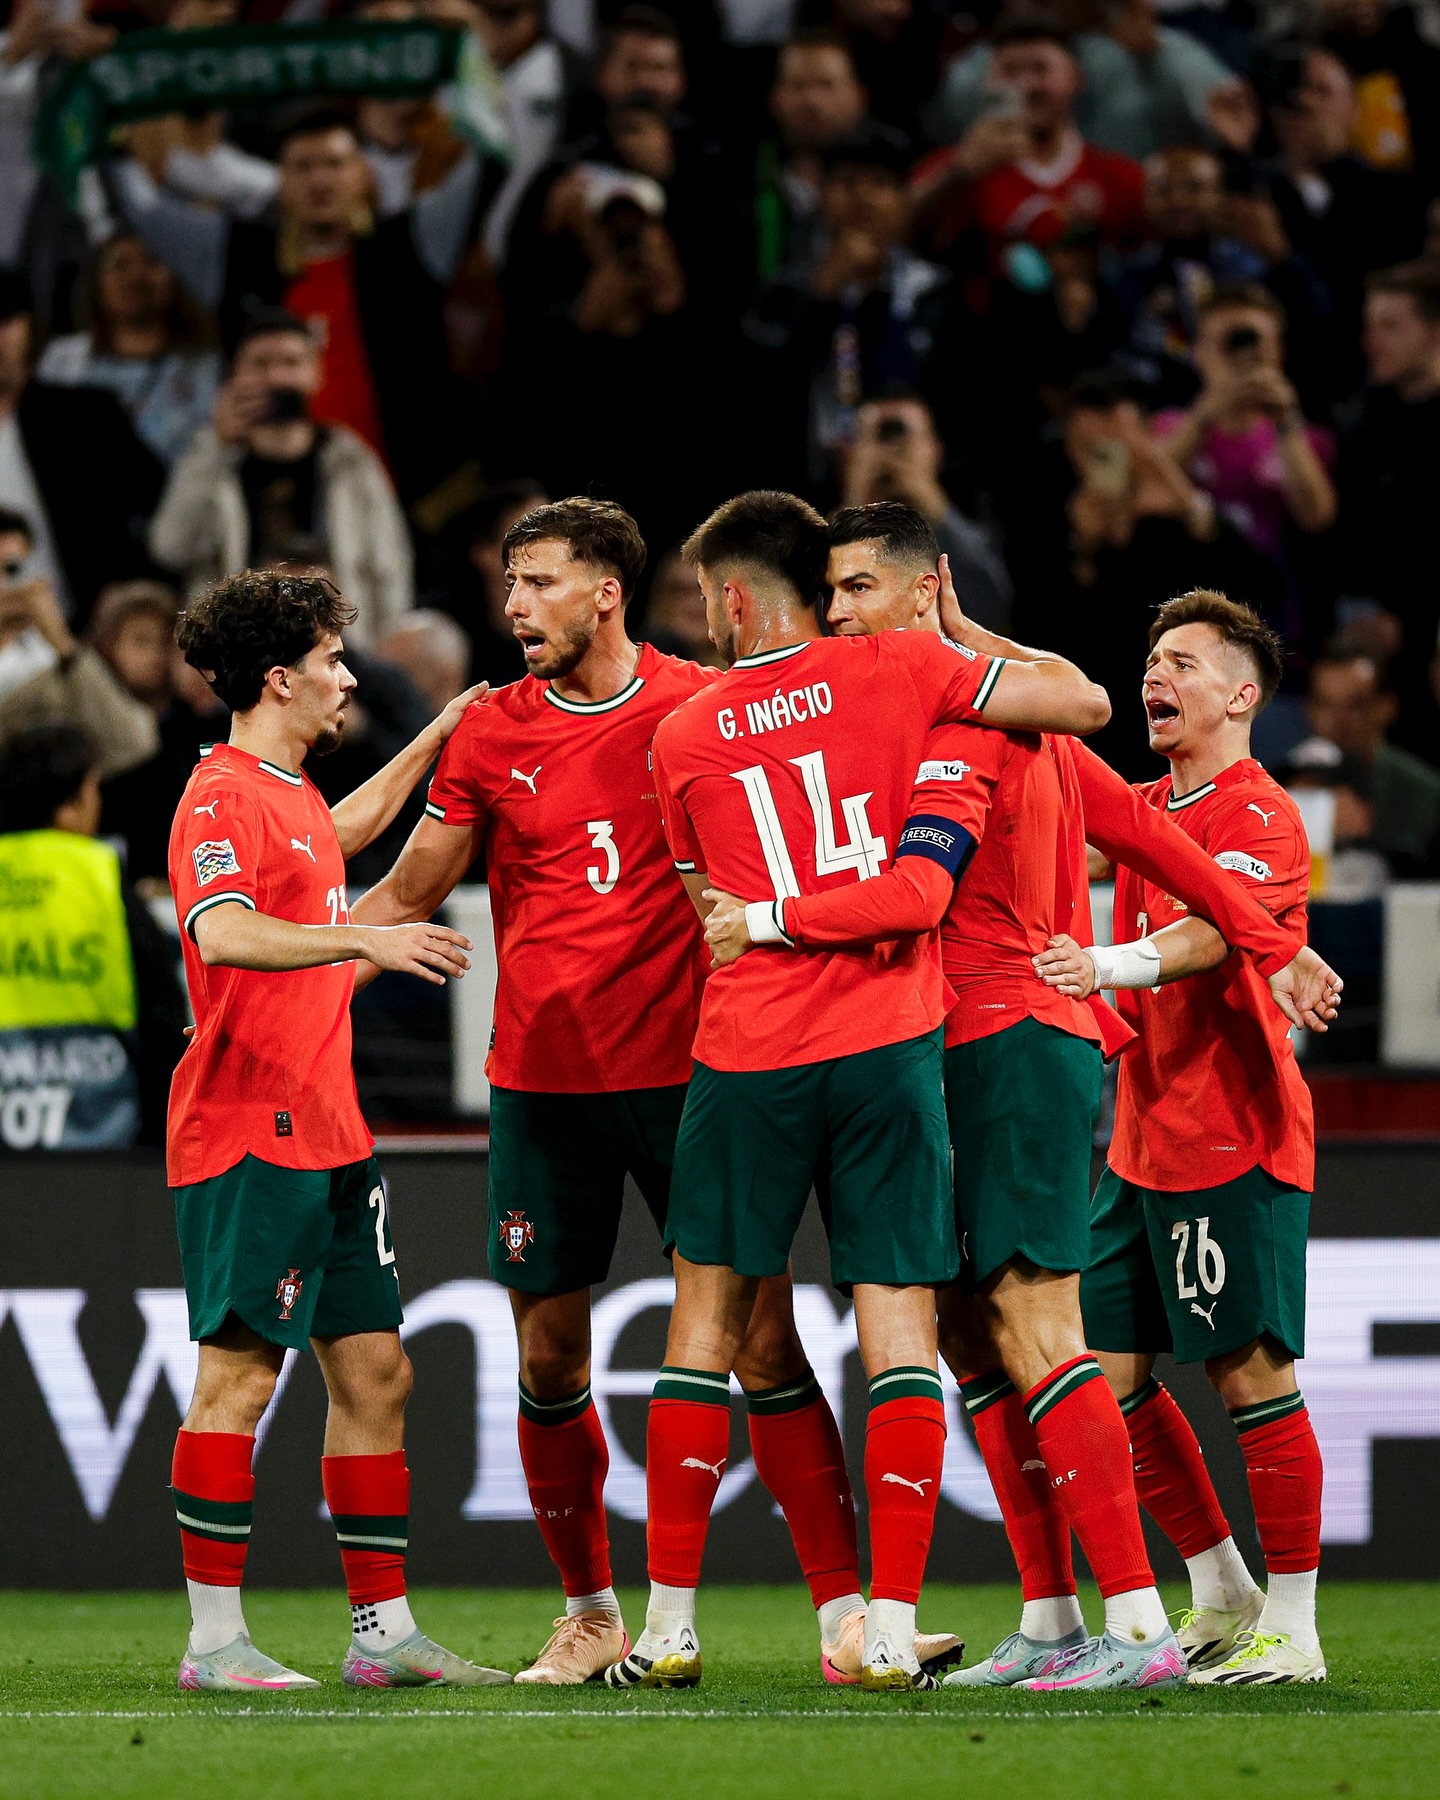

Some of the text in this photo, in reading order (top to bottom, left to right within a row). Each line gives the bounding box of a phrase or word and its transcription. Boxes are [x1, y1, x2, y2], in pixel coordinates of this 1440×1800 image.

[717, 681, 833, 740] G. INÁCIO
[587, 820, 620, 894] 3
[728, 749, 888, 899] 14
[906, 829, 954, 849] RESPECT
[1171, 1216, 1226, 1299] 26
